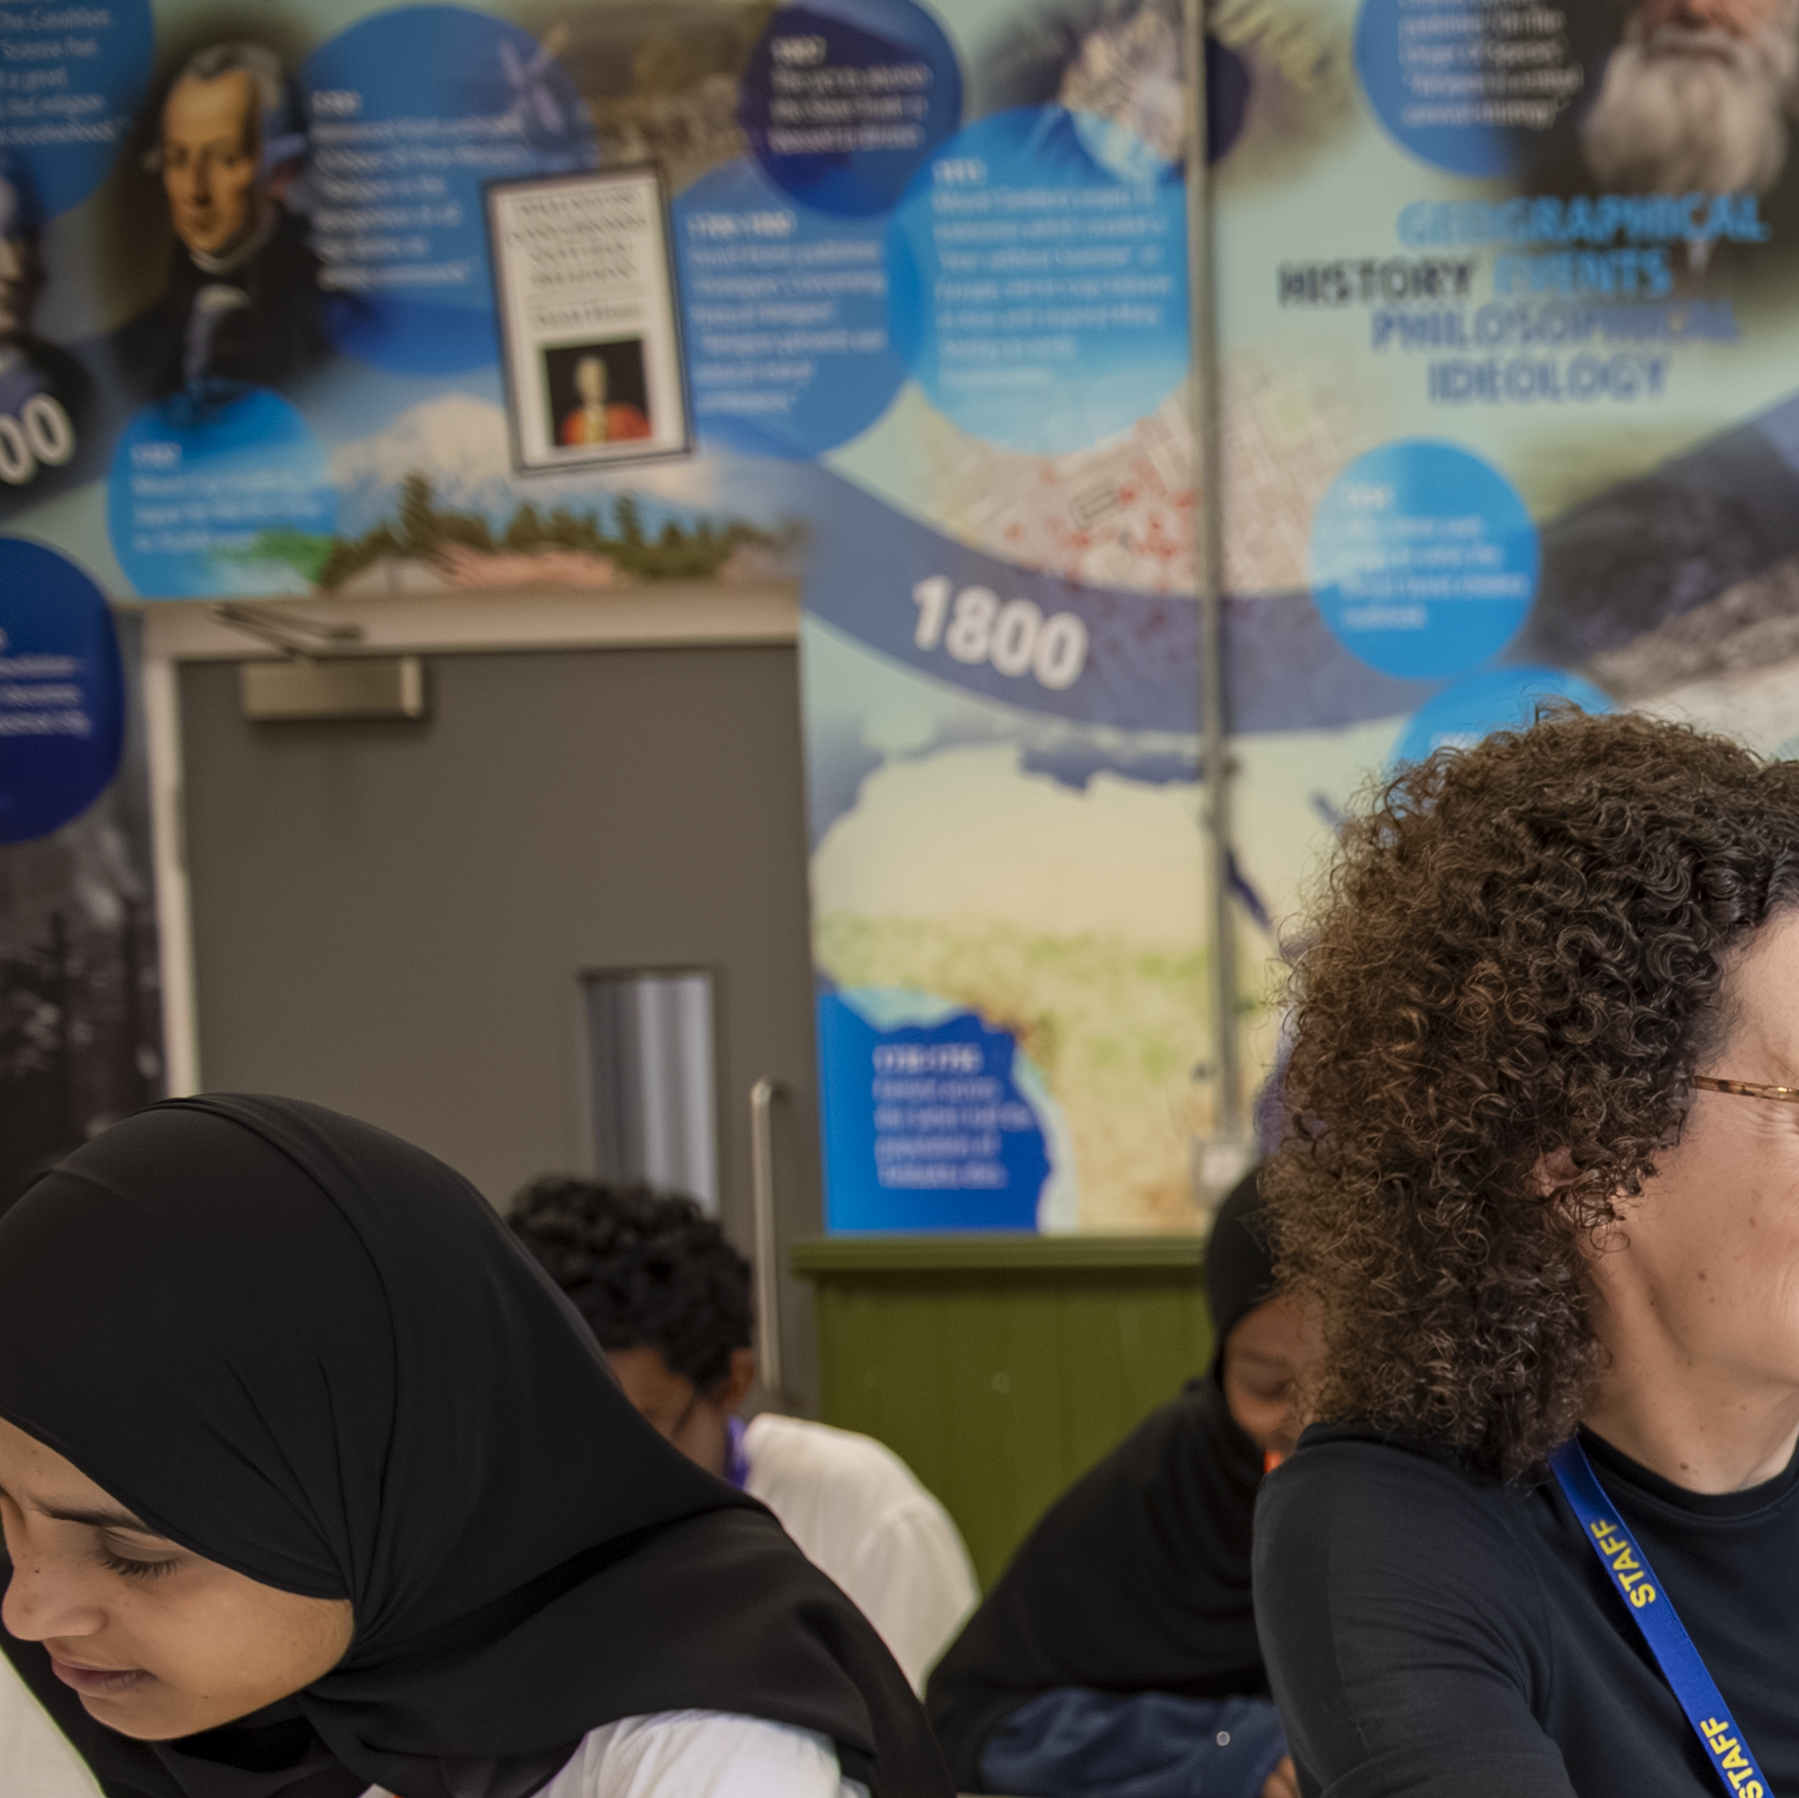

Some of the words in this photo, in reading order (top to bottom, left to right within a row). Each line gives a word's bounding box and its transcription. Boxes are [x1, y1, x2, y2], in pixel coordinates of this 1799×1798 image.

[1399, 194, 1770, 245] GEOGRAPHICAL
[1275, 257, 1480, 308] HISTORY
[1490, 248, 1674, 300] EVENTS
[1371, 300, 1745, 353] PHILOSOPHICAL
[1427, 355, 1670, 406] IDEOLOGY
[910, 572, 1091, 694] 1800
[1588, 1519, 1657, 1608] STAFF
